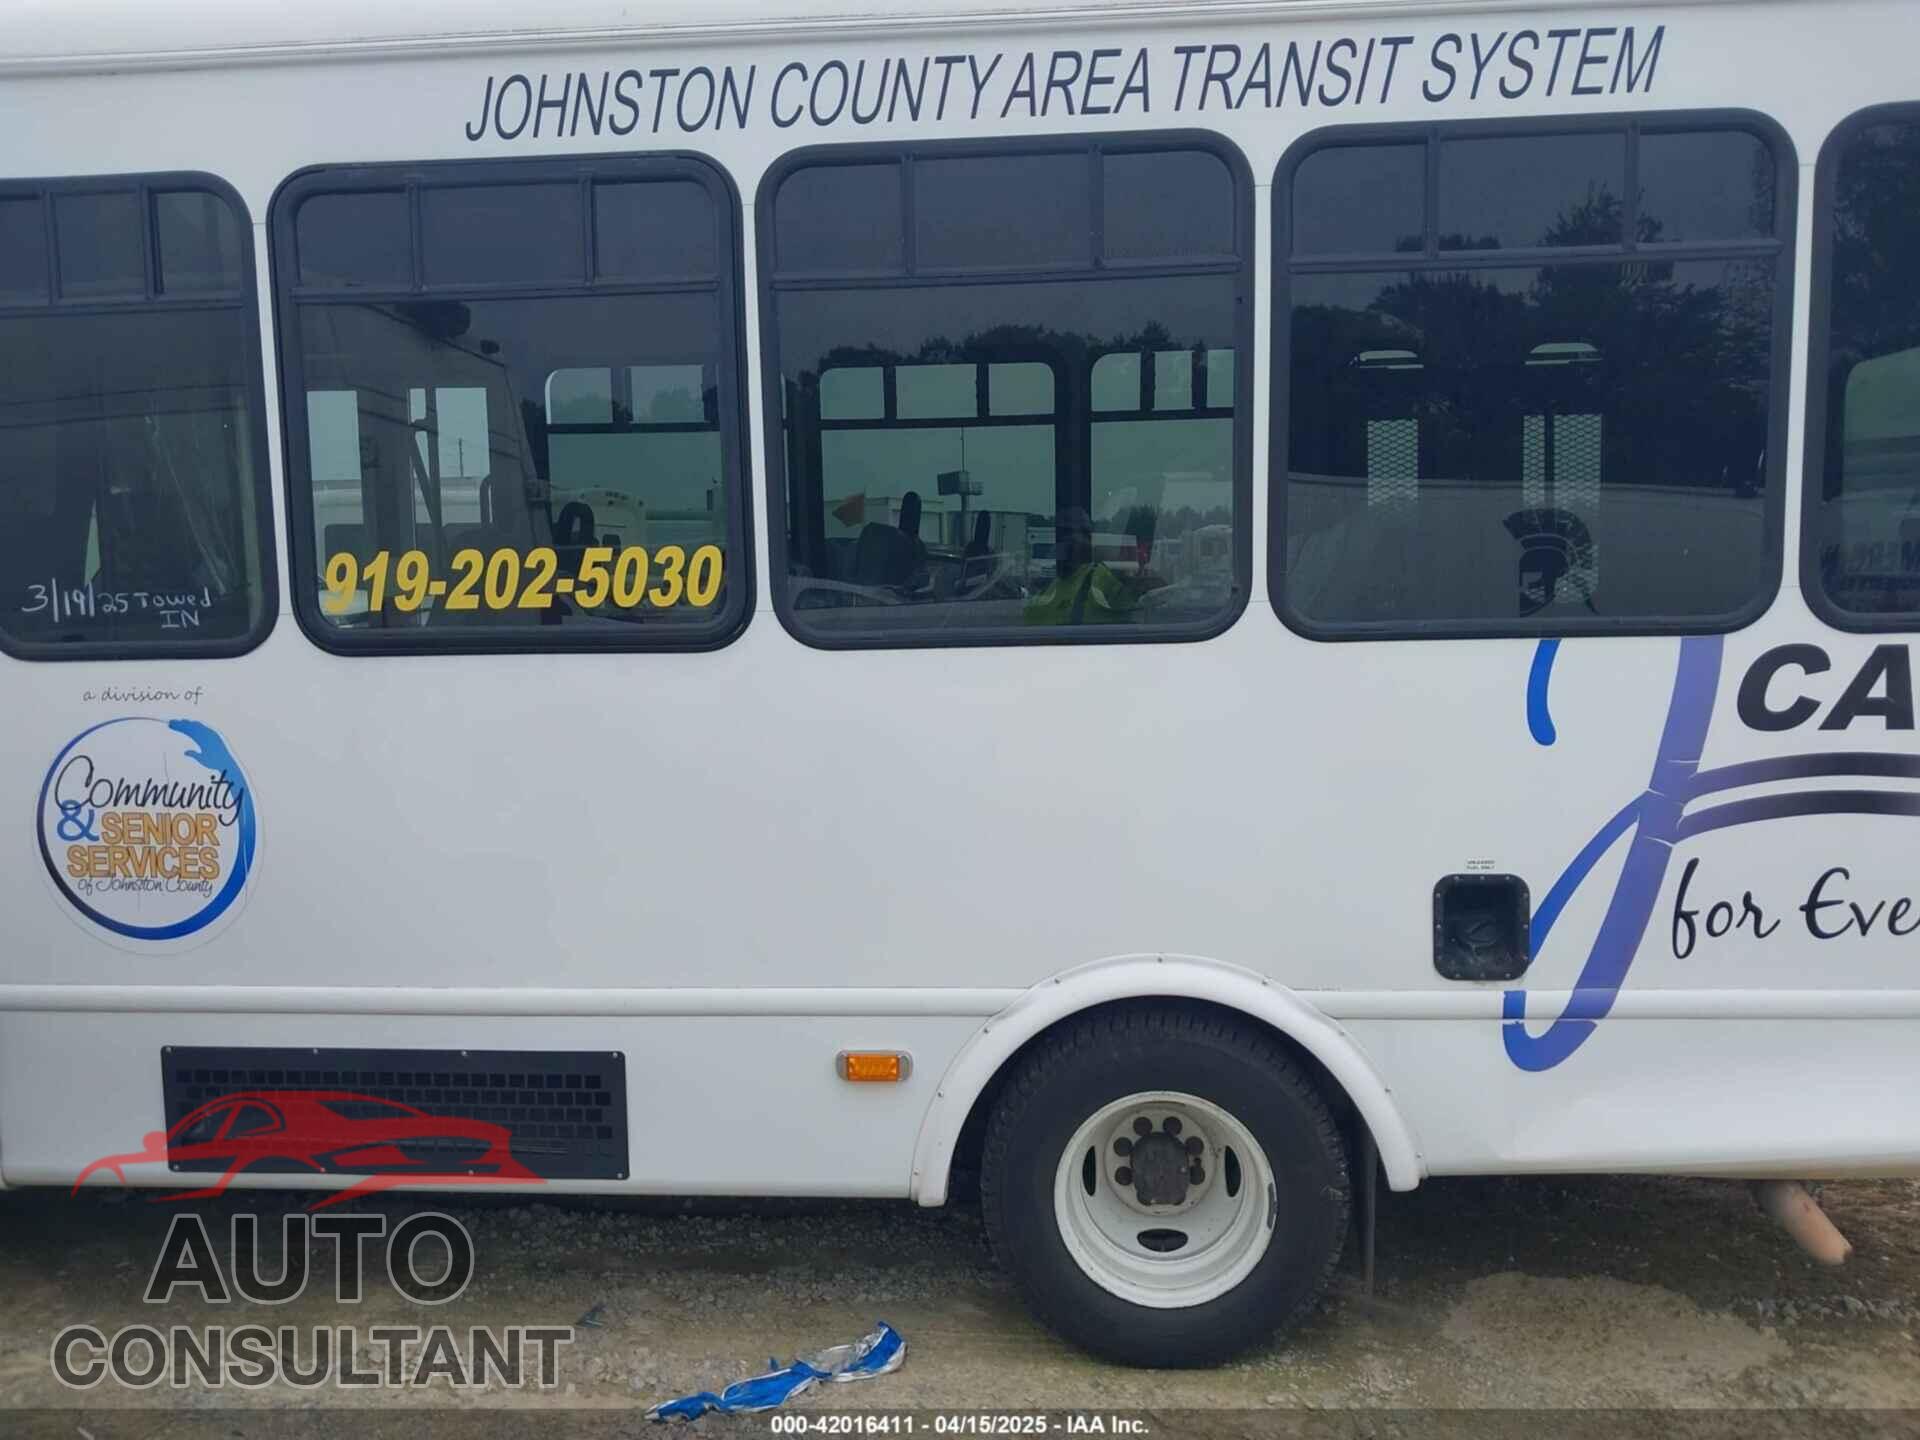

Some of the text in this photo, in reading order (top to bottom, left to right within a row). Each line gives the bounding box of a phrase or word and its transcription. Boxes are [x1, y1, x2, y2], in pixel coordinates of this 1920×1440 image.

[465, 25, 1665, 142] JOHNSTON COUNTY AREA TRANSIT SYSTEM
[324, 545, 723, 616] 919-202-5030
[160, 610, 200, 628] IN
[82, 686, 204, 705] a division of
[55, 755, 244, 827] Community
[56, 800, 220, 847] & SENIOR
[66, 844, 220, 880] SERVICES
[95, 874, 163, 893] Johnston
[165, 876, 213, 898] County
[1672, 857, 1781, 959] for
